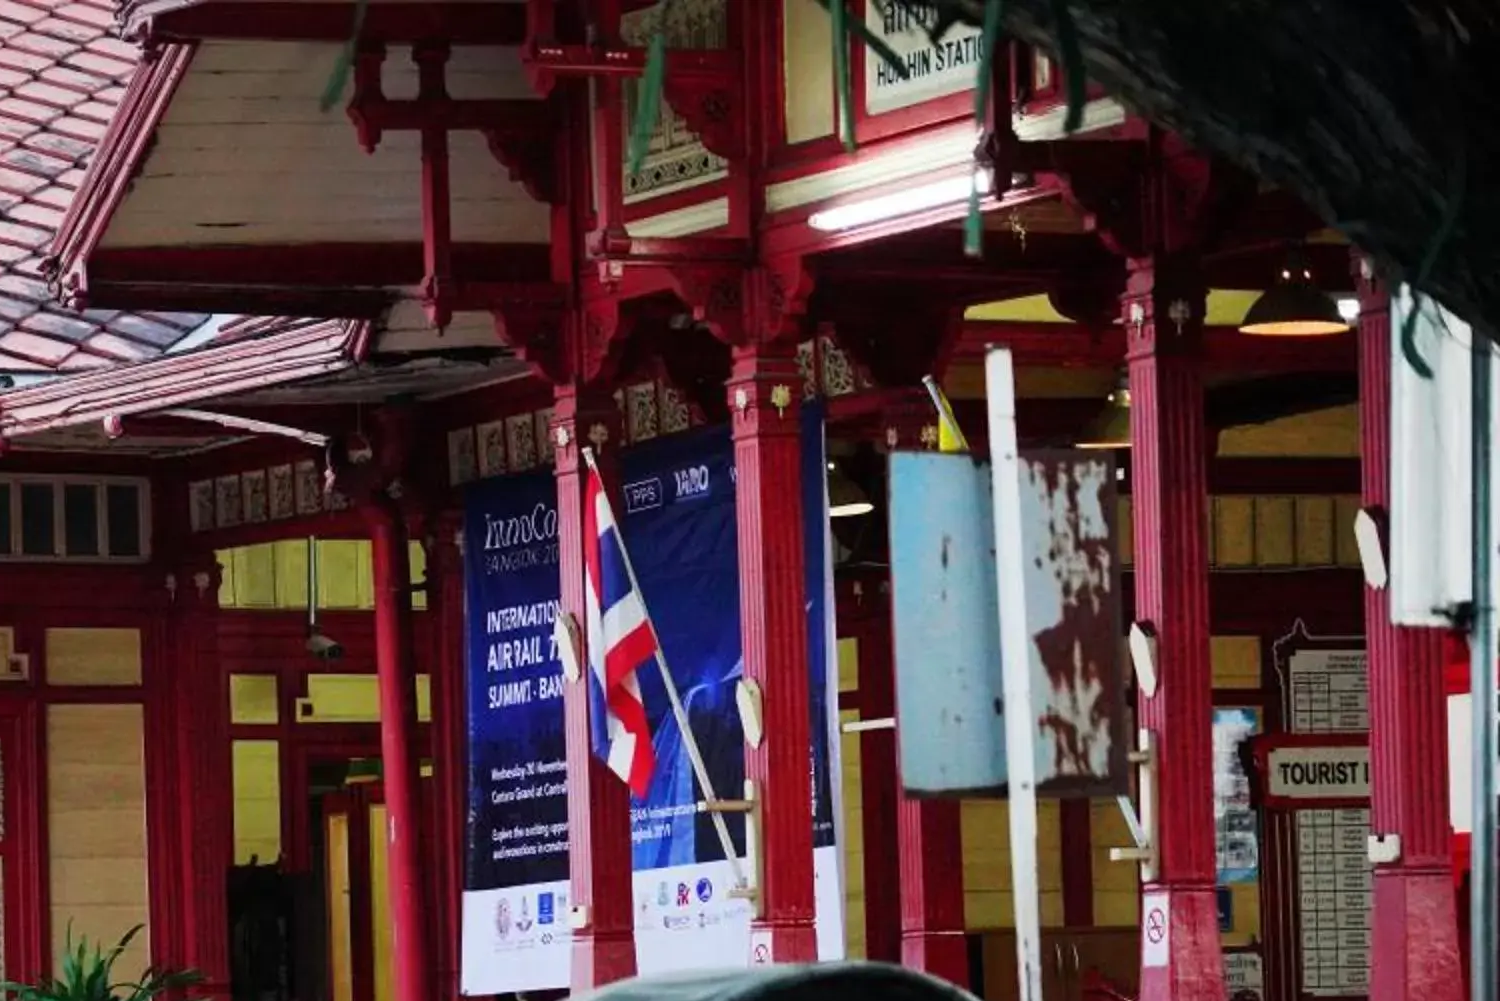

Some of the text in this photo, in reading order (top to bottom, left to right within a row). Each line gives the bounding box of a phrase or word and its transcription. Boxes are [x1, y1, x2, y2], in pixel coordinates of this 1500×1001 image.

[907, 48, 931, 77] HIN
[539, 674, 563, 699] BAN
[1280, 761, 1360, 786] TOURIST
